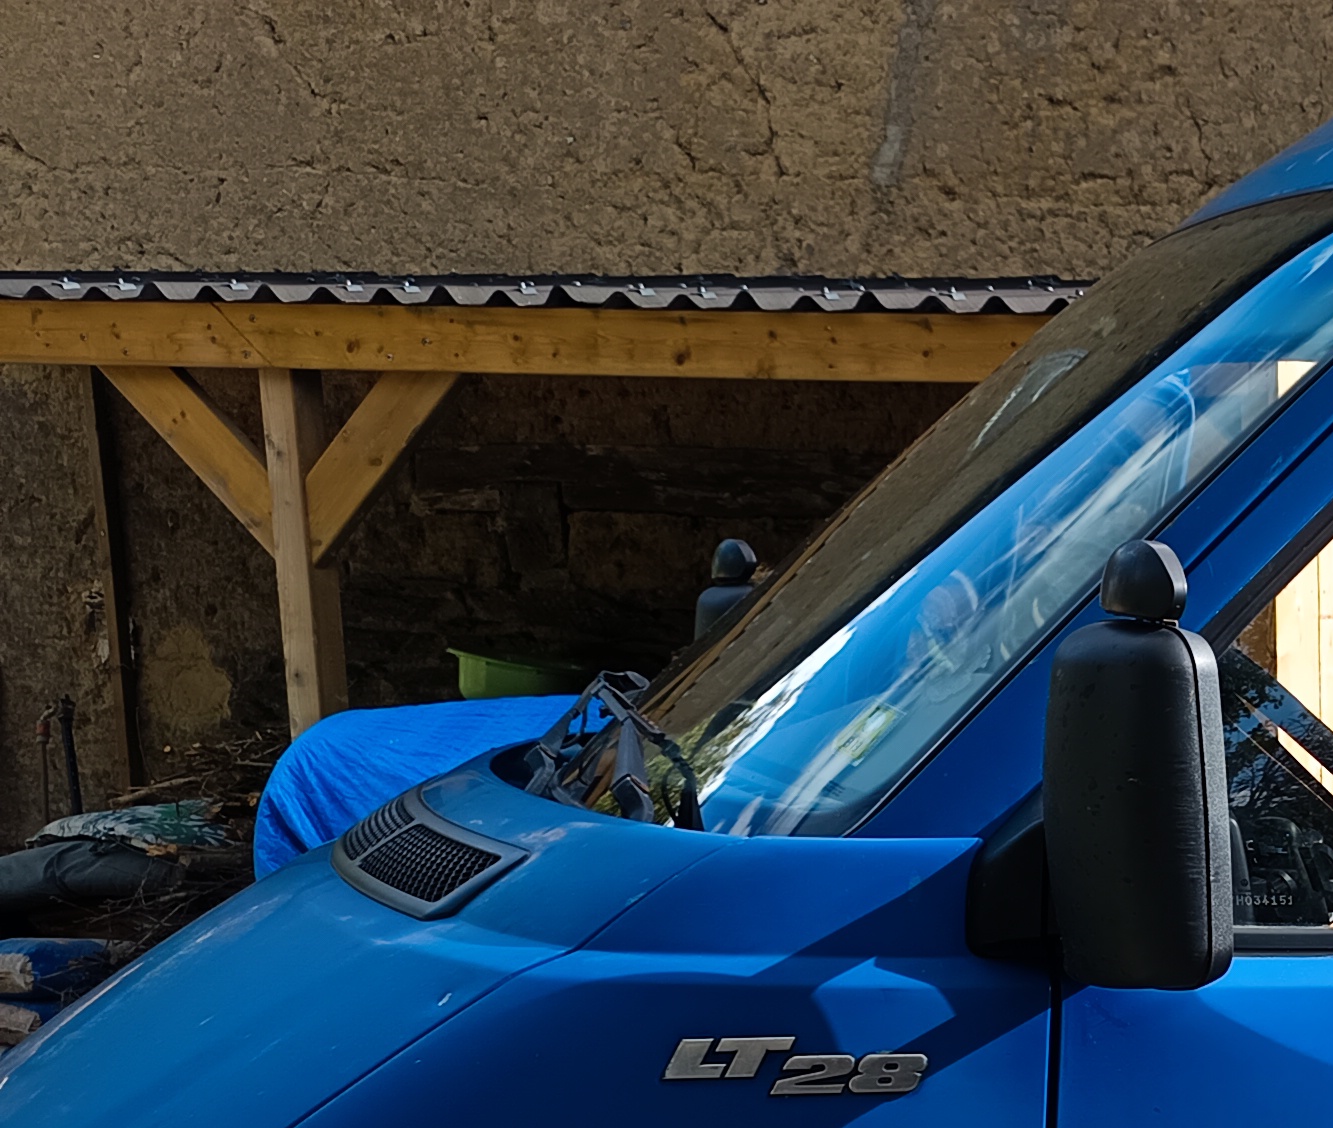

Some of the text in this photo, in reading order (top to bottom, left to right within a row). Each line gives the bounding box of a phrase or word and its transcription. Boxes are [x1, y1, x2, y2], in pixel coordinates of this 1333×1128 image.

[1231, 894, 1293, 907] H034151
[662, 1036, 929, 1096] LT 28
